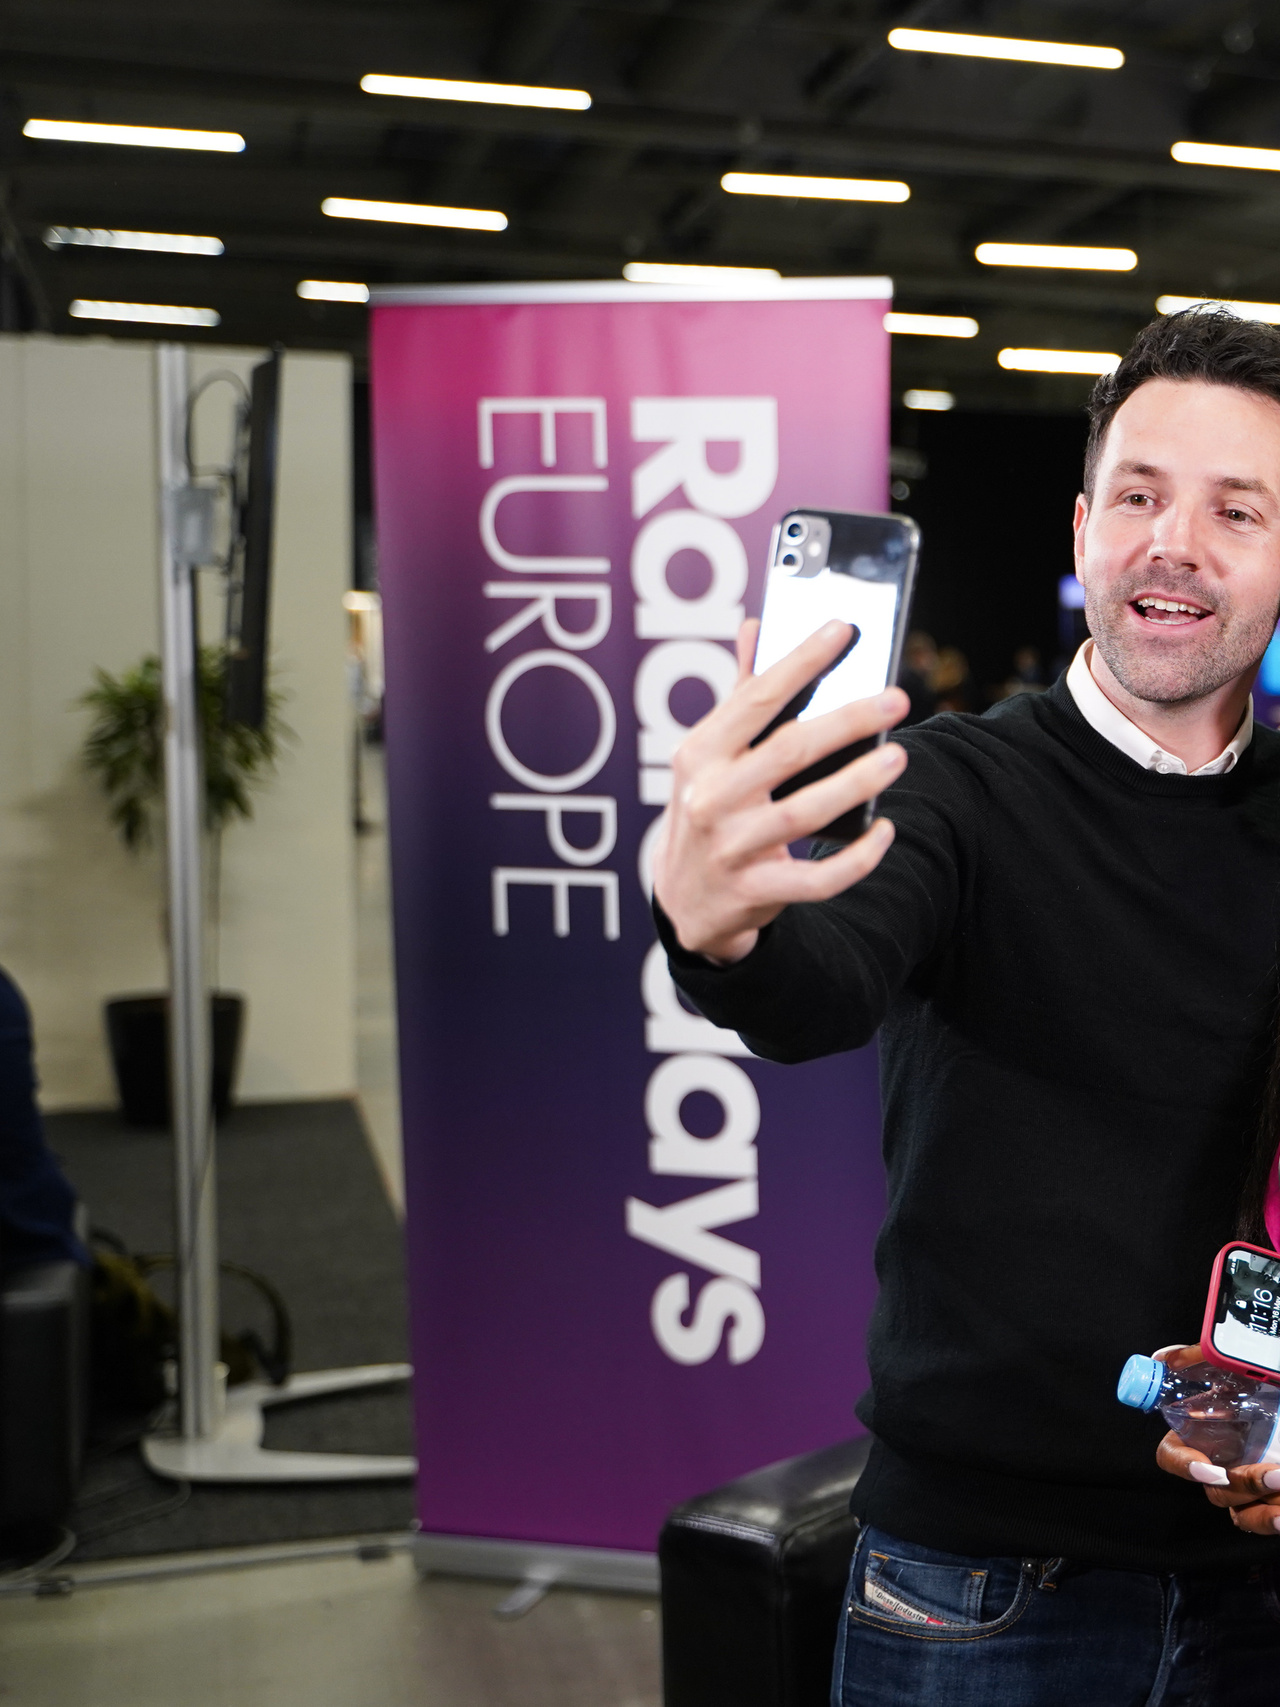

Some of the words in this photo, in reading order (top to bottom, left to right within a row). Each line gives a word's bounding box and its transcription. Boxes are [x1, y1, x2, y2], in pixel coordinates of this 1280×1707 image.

[477, 396, 620, 940] EUROPE
[1249, 1288, 1273, 1330] 11:16
[1272, 1310, 1280, 1319] 16
[1270, 1319, 1278, 1334] Mon
[877, 1591, 897, 1607] Diesel
